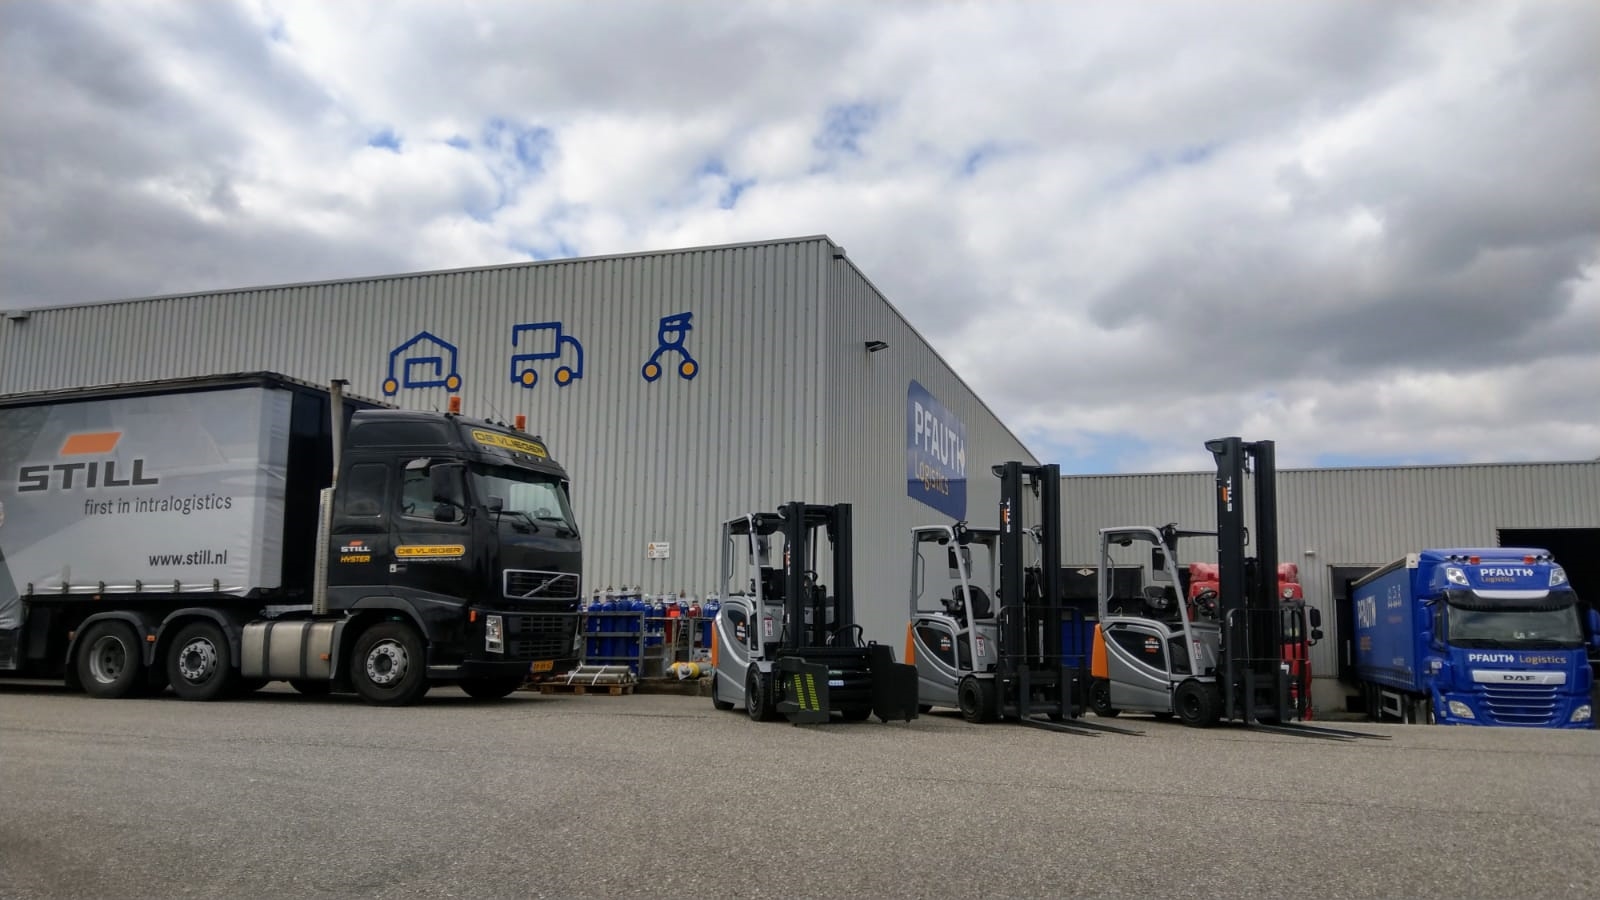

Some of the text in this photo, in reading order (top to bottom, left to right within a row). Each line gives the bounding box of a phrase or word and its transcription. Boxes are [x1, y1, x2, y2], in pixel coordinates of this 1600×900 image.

[496, 436, 545, 454] VLIEGER
[18, 459, 159, 492] STILL
[915, 451, 949, 496] Logistics
[84, 493, 232, 515] first in intralogistics
[149, 550, 227, 566] www.still.nl
[340, 555, 371, 563] HYSTER
[1480, 568, 1534, 576] PFAUTH
[1468, 654, 1567, 664] PFAUTH Logistics
